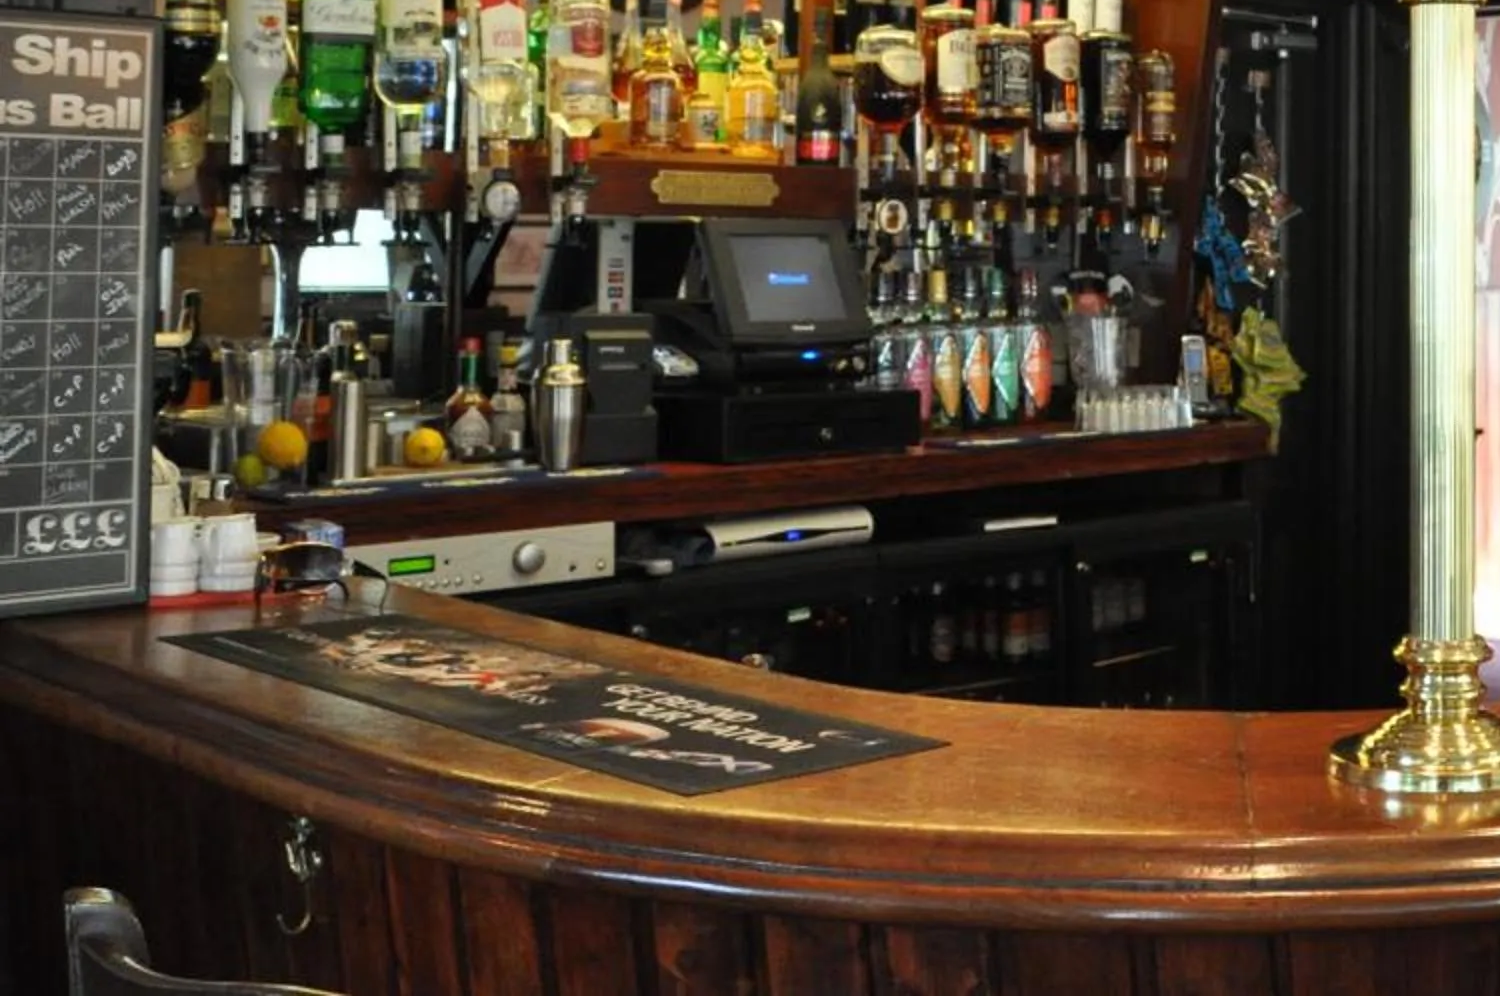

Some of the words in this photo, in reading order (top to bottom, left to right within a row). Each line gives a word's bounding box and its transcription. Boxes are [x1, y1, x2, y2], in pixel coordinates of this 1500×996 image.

[12, 33, 143, 89] Ship
[50, 93, 143, 131] Ball
[678, 718, 816, 753] NATION
